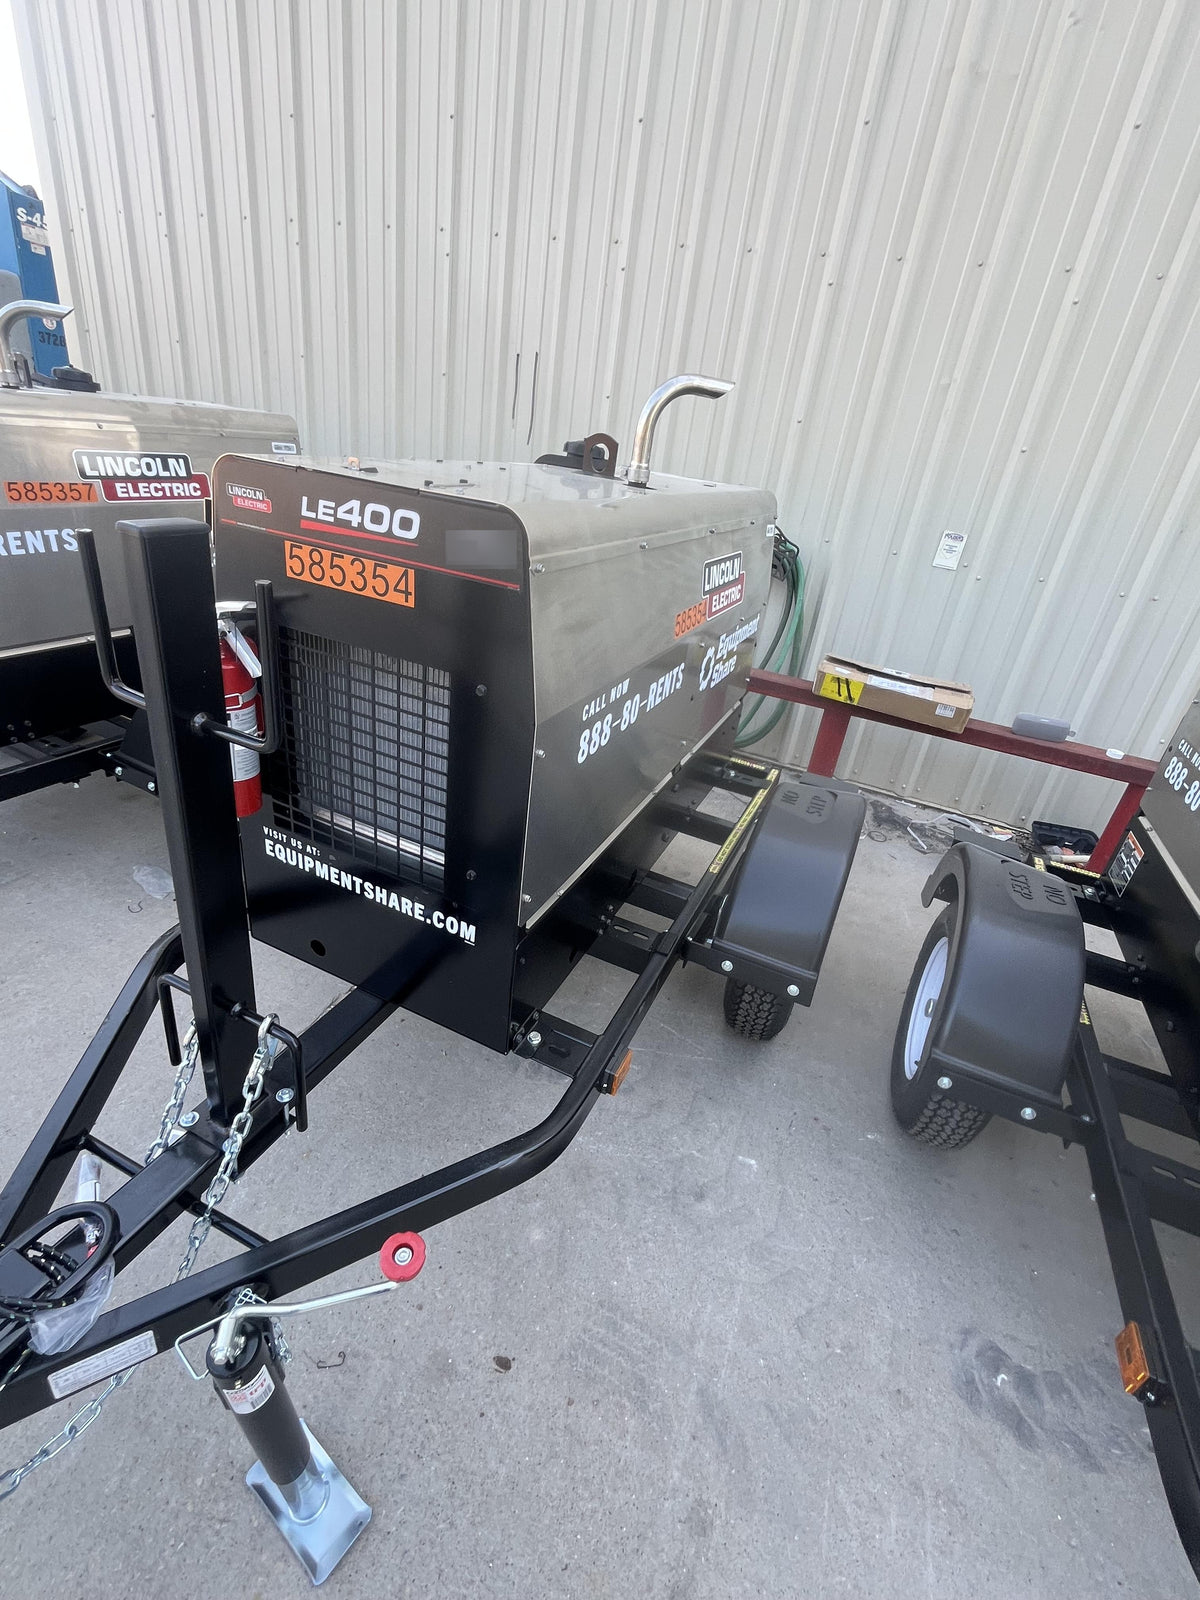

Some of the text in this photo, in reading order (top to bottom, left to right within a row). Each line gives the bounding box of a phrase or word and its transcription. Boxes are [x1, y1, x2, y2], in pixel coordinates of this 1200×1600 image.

[82, 455, 188, 478] LINCOLN
[7, 481, 94, 502] 585357
[114, 481, 202, 499] ELECTRIC
[228, 485, 264, 501] LINCOLN
[237, 498, 269, 511] ELECTRIC
[301, 496, 421, 540] LE400
[288, 543, 413, 604] 585354
[704, 556, 741, 592] LINCOLN
[711, 584, 742, 613] ELECTRIC
[716, 613, 760, 660] Equipment
[710, 655, 737, 689] Share
[578, 662, 685, 764] 888-80-RENTS
[582, 678, 630, 721] CALL NOW
[1178, 739, 1200, 772] CALL NO
[780, 790, 800, 806] NO
[806, 795, 827, 817] STEP
[262, 825, 321, 857] VISIT US AT:
[264, 838, 477, 943] EQUIPMENTSHARE.COM
[1008, 871, 1034, 900] STEP
[1043, 884, 1067, 906] NO
